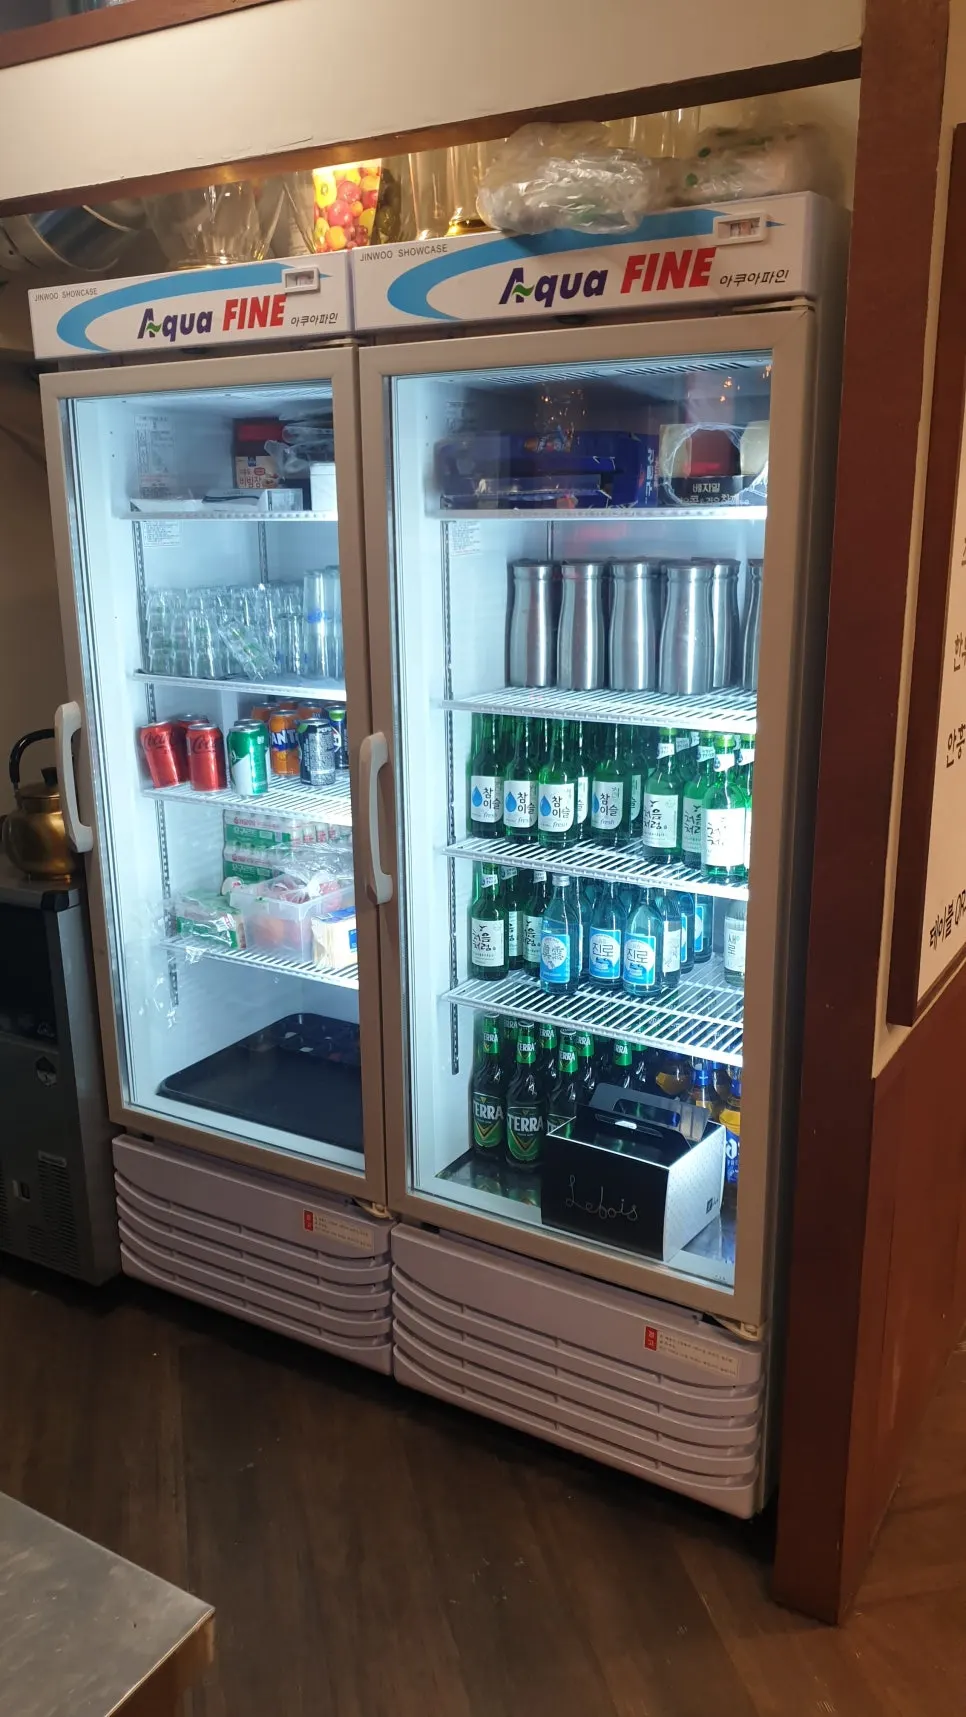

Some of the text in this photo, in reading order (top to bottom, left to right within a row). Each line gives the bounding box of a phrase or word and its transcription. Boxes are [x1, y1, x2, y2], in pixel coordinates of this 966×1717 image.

[360, 243, 448, 262] JINWOO SHOWCASE
[499, 247, 717, 307] Aqua FINE
[719, 269, 790, 288] 아쿠아파인
[34, 287, 99, 302] JINWOO SHOWCASE
[137, 293, 288, 342] Aqua FINE
[290, 312, 339, 327] 아쿠아파인
[592, 942, 614, 957] 진로
[626, 948, 649, 963] 진로
[473, 1100, 504, 1120] TERRA
[507, 1113, 544, 1133] TERRA
